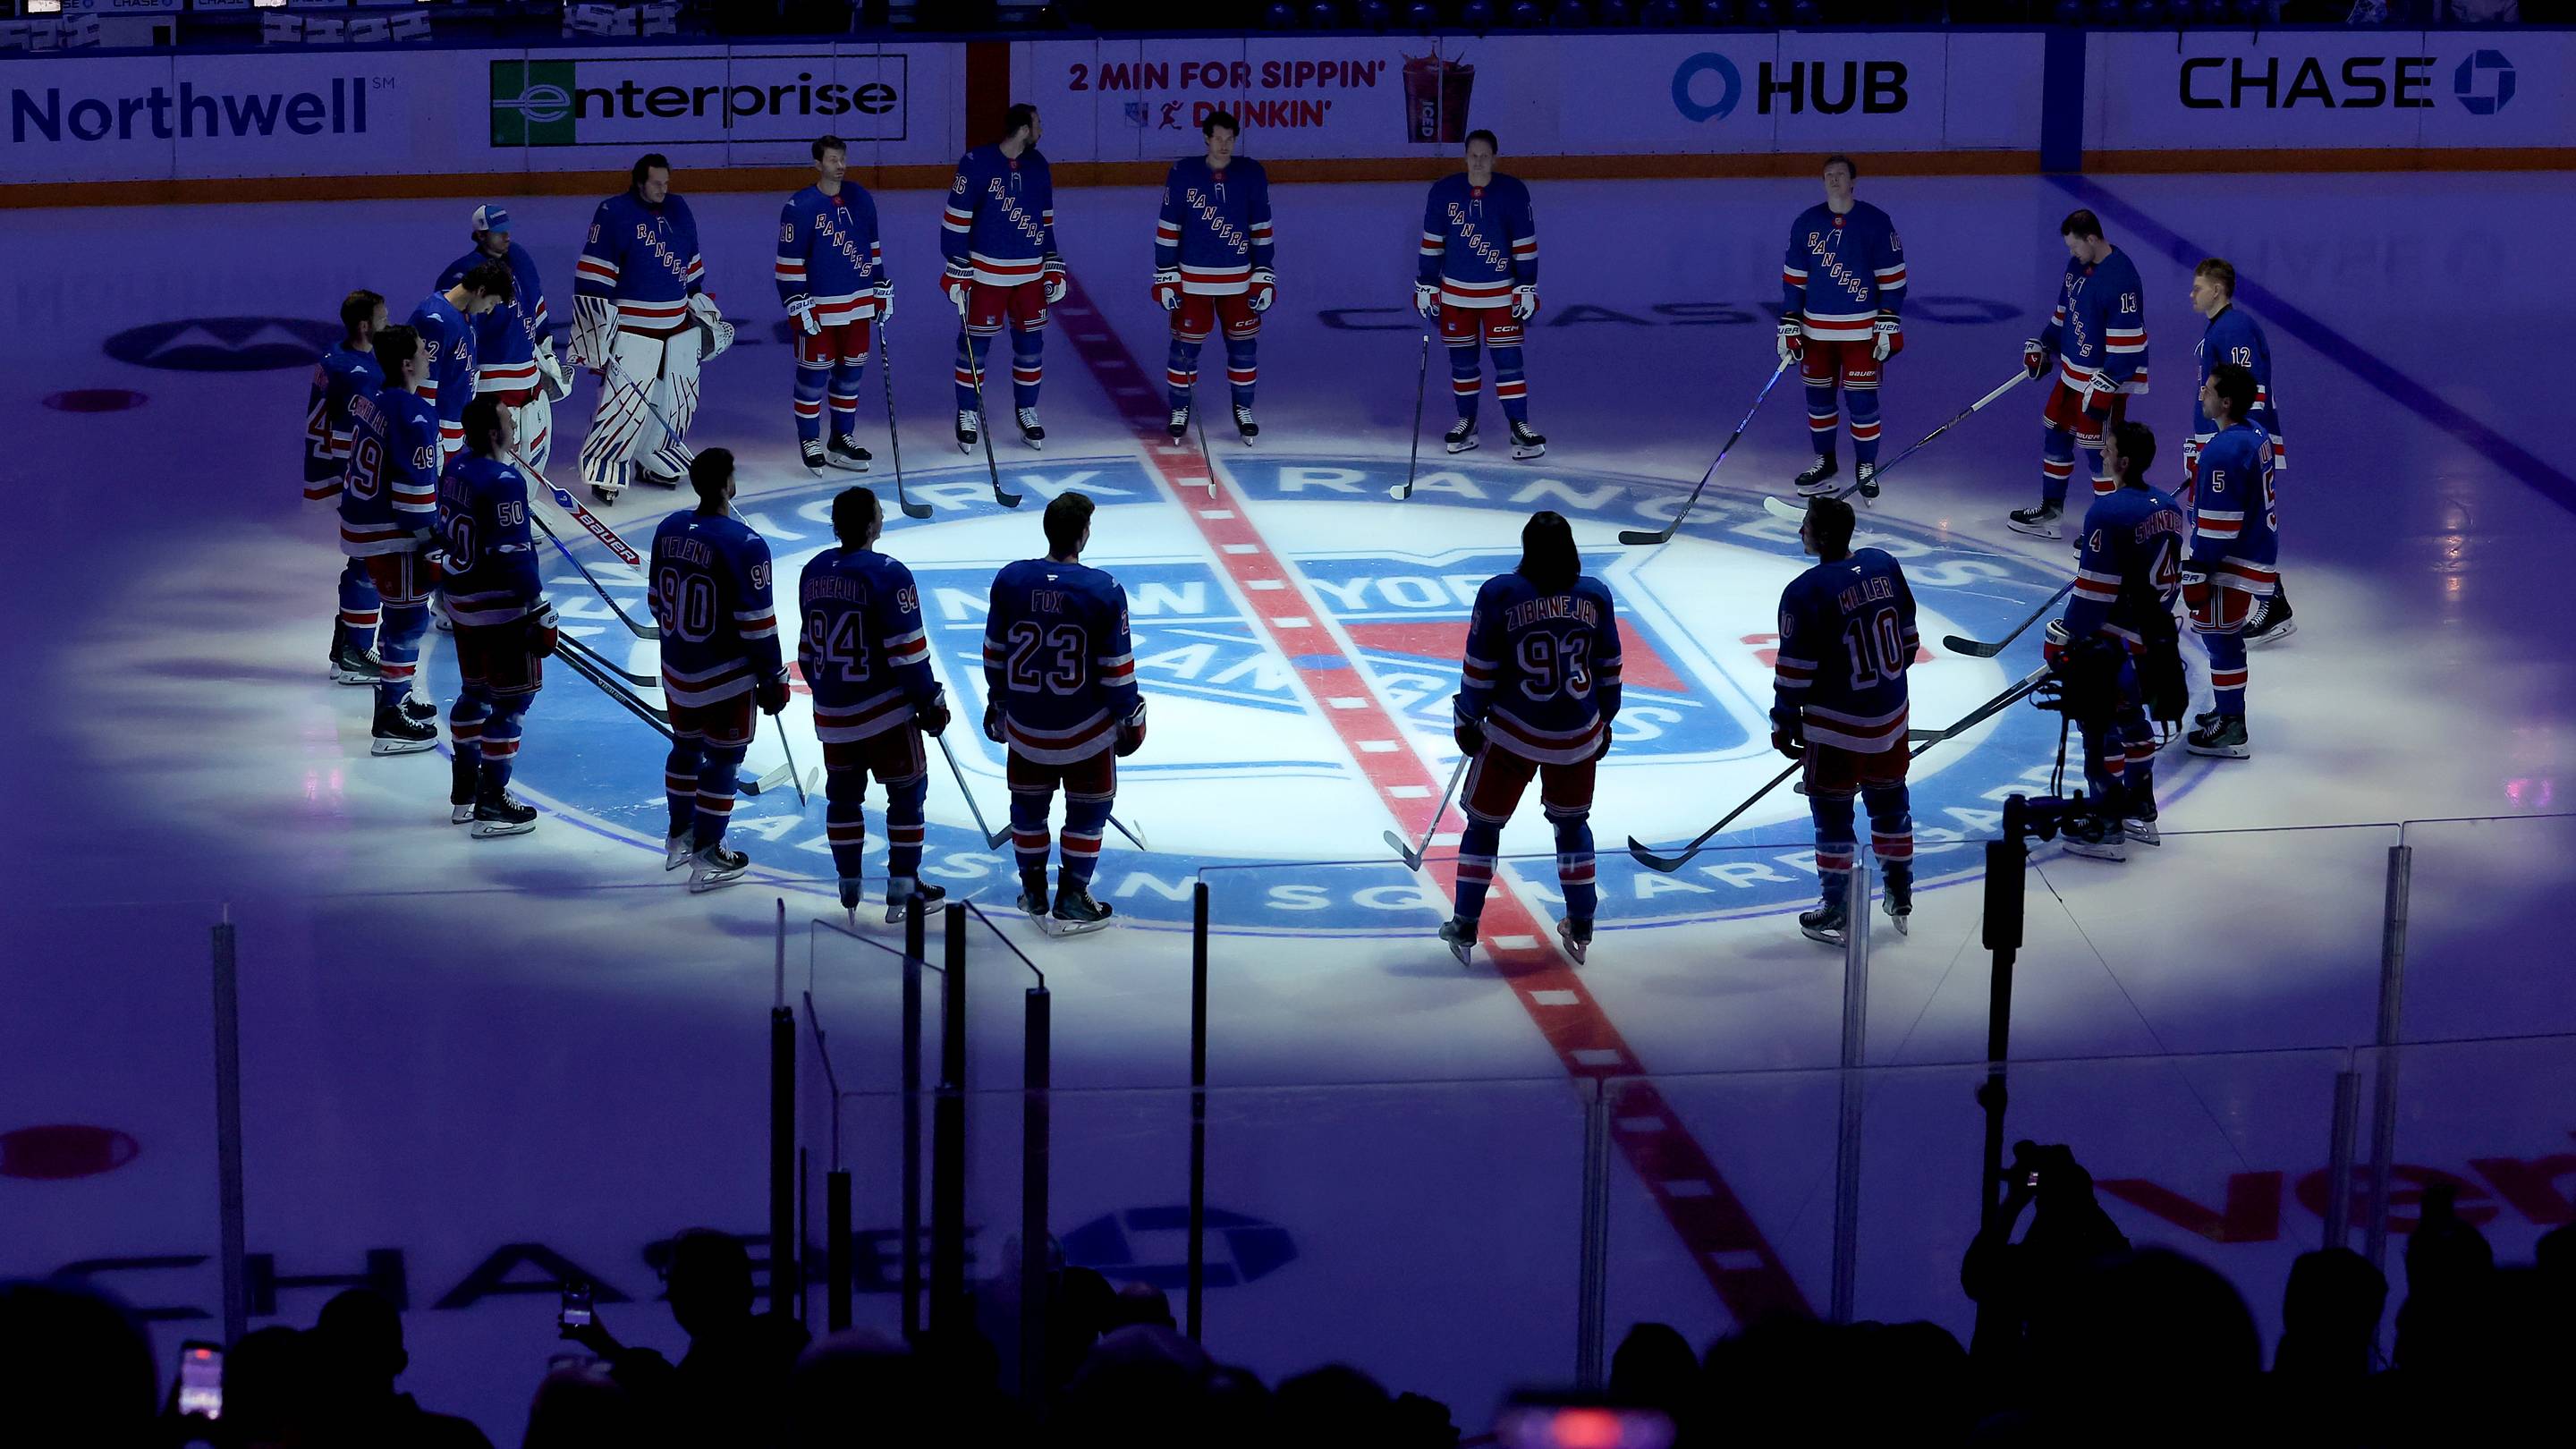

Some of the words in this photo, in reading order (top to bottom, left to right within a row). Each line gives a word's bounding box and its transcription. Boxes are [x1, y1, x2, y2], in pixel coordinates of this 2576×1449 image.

[516, 72, 897, 129] enterprise
[1070, 64, 1089, 90] 2
[1098, 63, 1169, 89] MIN
[1180, 62, 1251, 89] FOR
[1261, 60, 1385, 88] SIPPIN'
[1758, 61, 1908, 114] HUB
[2179, 56, 2437, 108] CHASE
[12, 77, 366, 142] Northwell
[372, 77, 394, 89] SM
[1422, 100, 1435, 137] ICED
[988, 178, 1045, 245] RANGERS
[1186, 188, 1248, 254] RANGERS
[1448, 203, 1508, 271] RANGERS
[637, 223, 689, 288] RANGER
[815, 213, 872, 277] RANGERS
[1808, 232, 1868, 301] RANGERS
[2121, 292, 2138, 313] 13
[2231, 346, 2251, 368] 12
[412, 445, 436, 470] 49
[2212, 470, 2225, 492] 5
[496, 500, 525, 527] 50
[579, 514, 636, 560] BAUER
[2089, 529, 2102, 553] 4
[659, 565, 716, 643] 90
[897, 583, 919, 614] 94
[1031, 589, 1065, 614] FOX
[1838, 577, 1894, 614] MILLER
[809, 609, 869, 682] 94
[1007, 620, 1087, 696] 23
[1517, 628, 1592, 702] 93
[1843, 606, 1903, 691] 10
